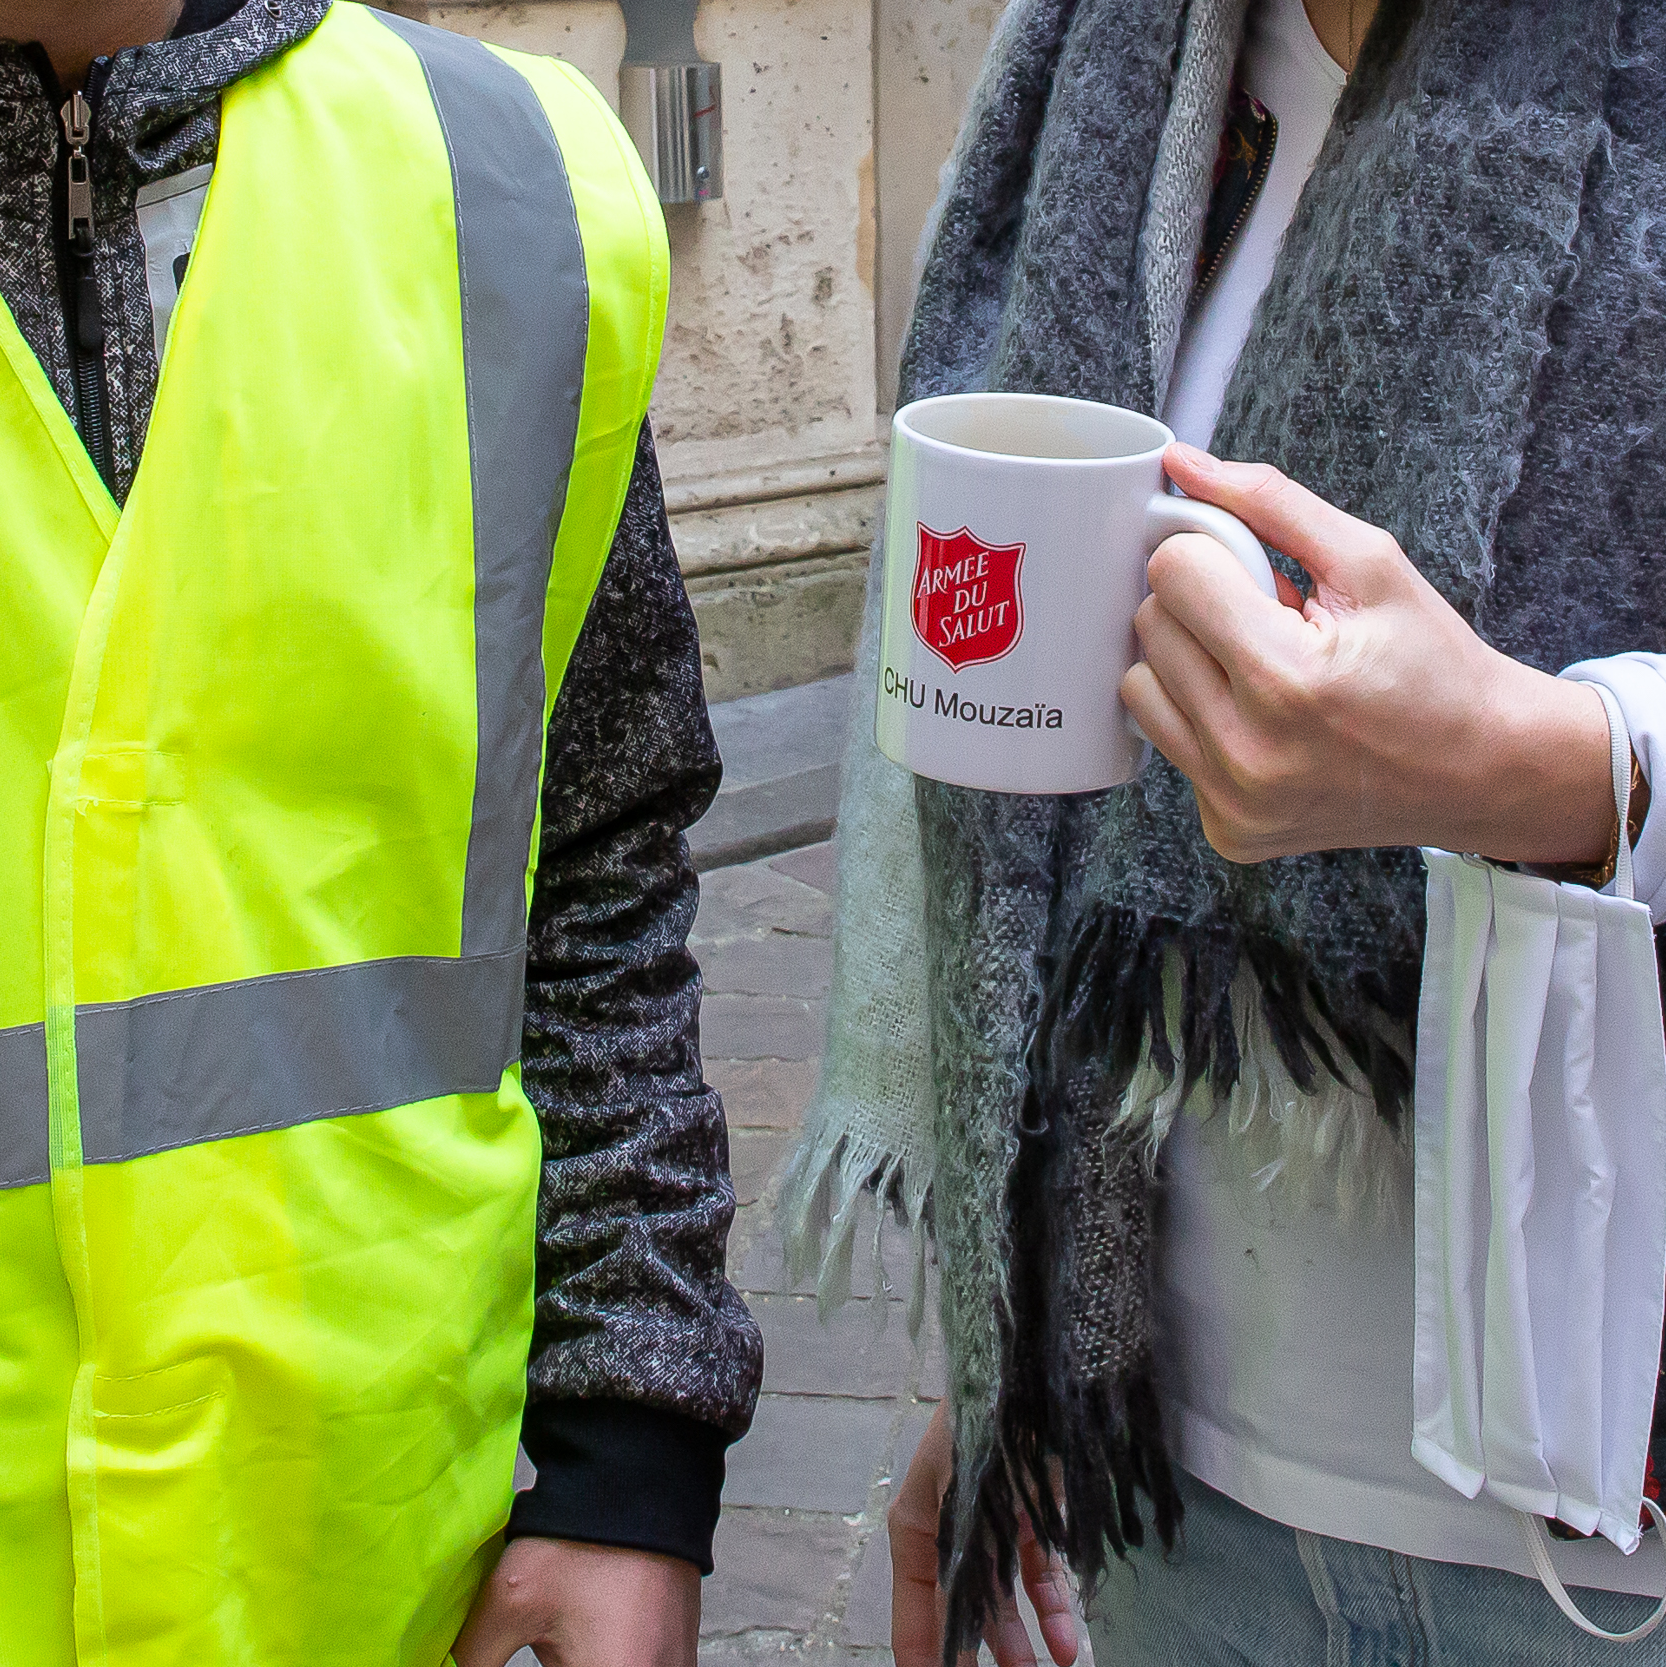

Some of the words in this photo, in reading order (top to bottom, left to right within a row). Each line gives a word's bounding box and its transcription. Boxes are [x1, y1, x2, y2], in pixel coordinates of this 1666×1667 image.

[915, 551, 990, 599] ARMÉE
[952, 580, 988, 615] DU
[938, 599, 1010, 648] SALUT
[884, 666, 926, 709] CHU
[934, 687, 1063, 729] Mouzaïa
